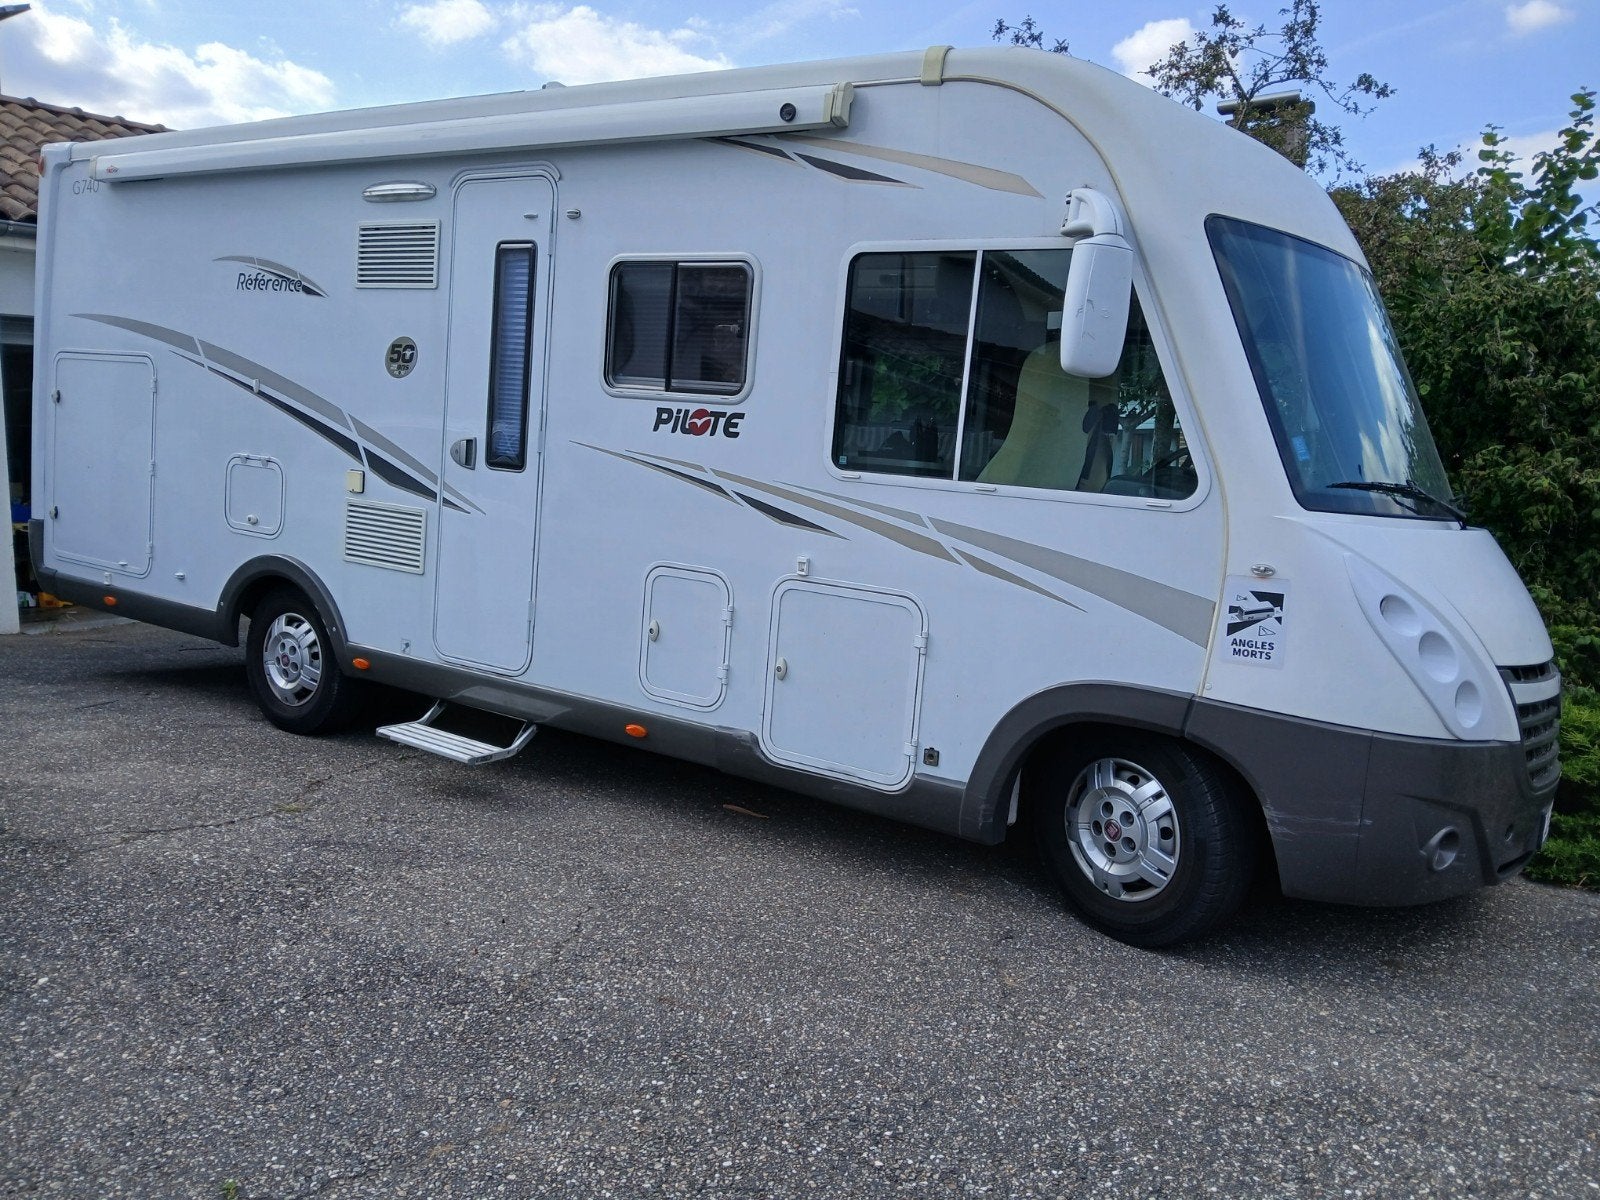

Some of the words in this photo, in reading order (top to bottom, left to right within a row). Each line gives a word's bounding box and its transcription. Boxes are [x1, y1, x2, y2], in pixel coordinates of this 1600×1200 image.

[236, 272, 302, 293] Référence
[389, 344, 415, 364] 50
[1230, 638, 1275, 651] ANGLES
[1232, 648, 1272, 660] MORTS
